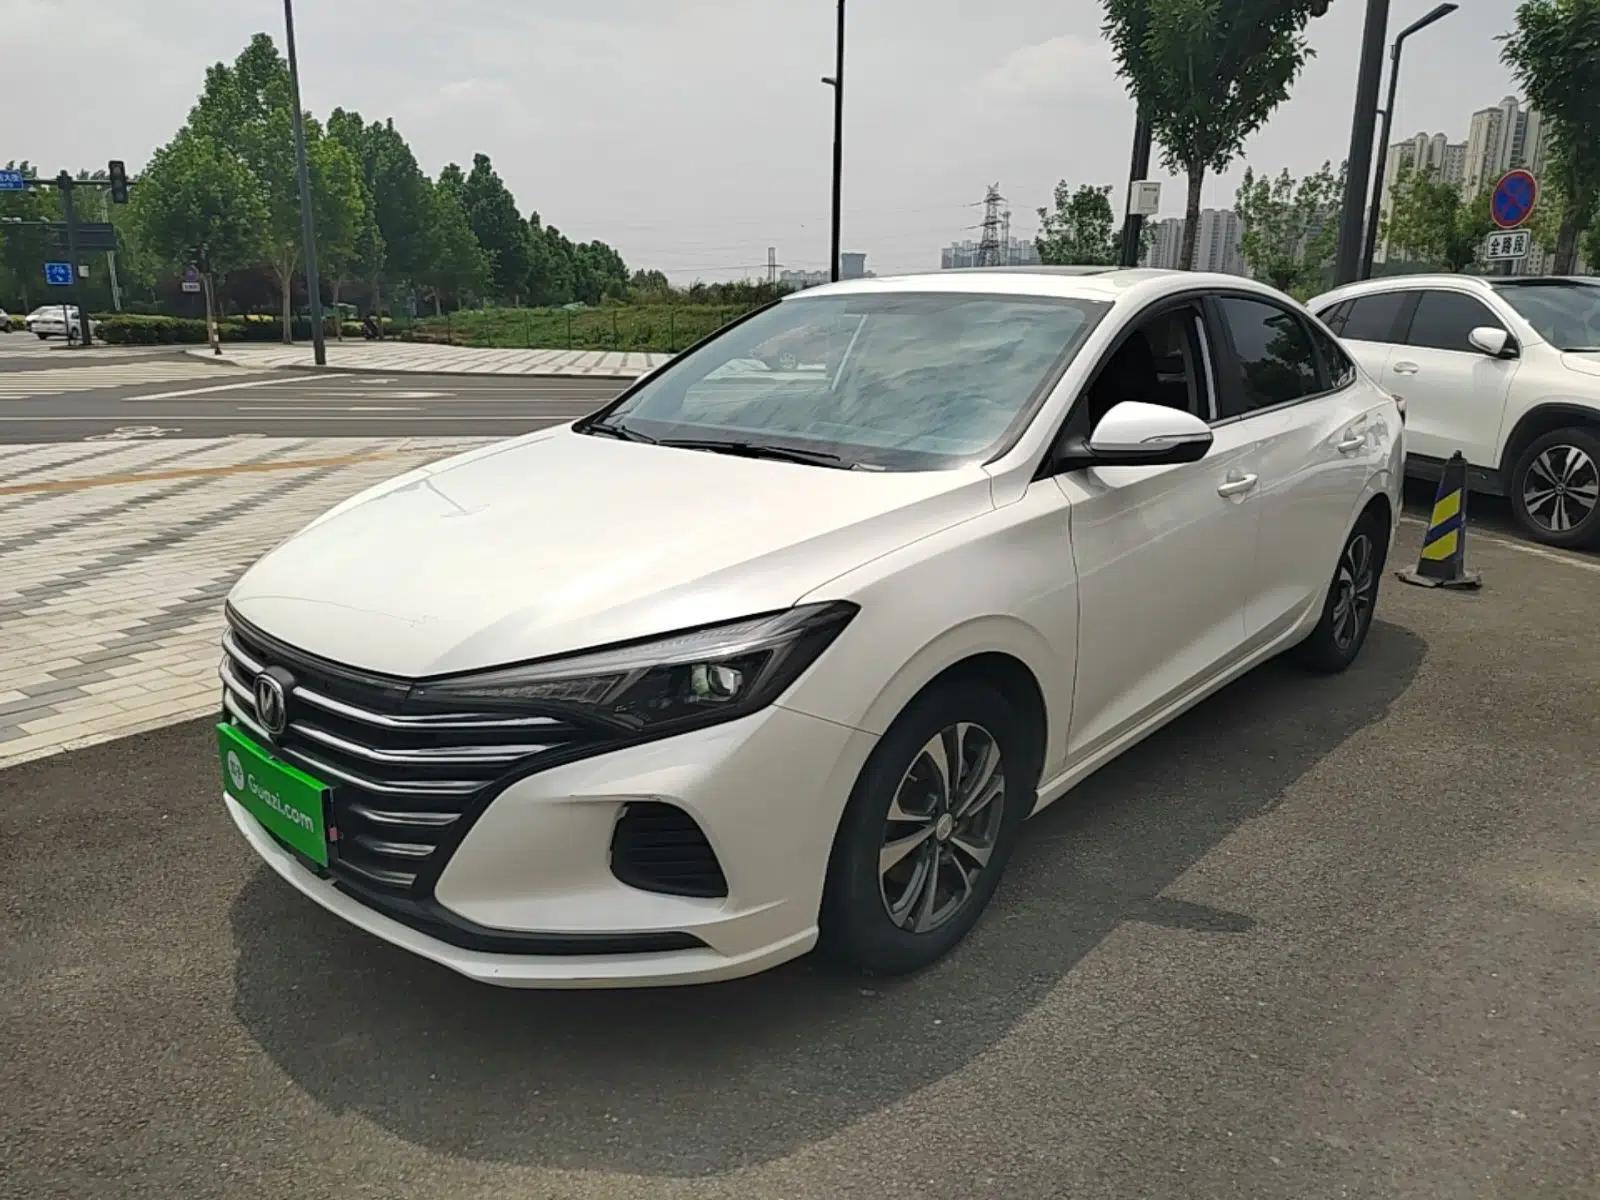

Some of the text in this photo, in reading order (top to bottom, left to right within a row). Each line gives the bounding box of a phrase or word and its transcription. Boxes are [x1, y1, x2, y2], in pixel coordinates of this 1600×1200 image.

[1490, 235, 1524, 256] 全路段
[247, 773, 314, 833] Guazi.com
